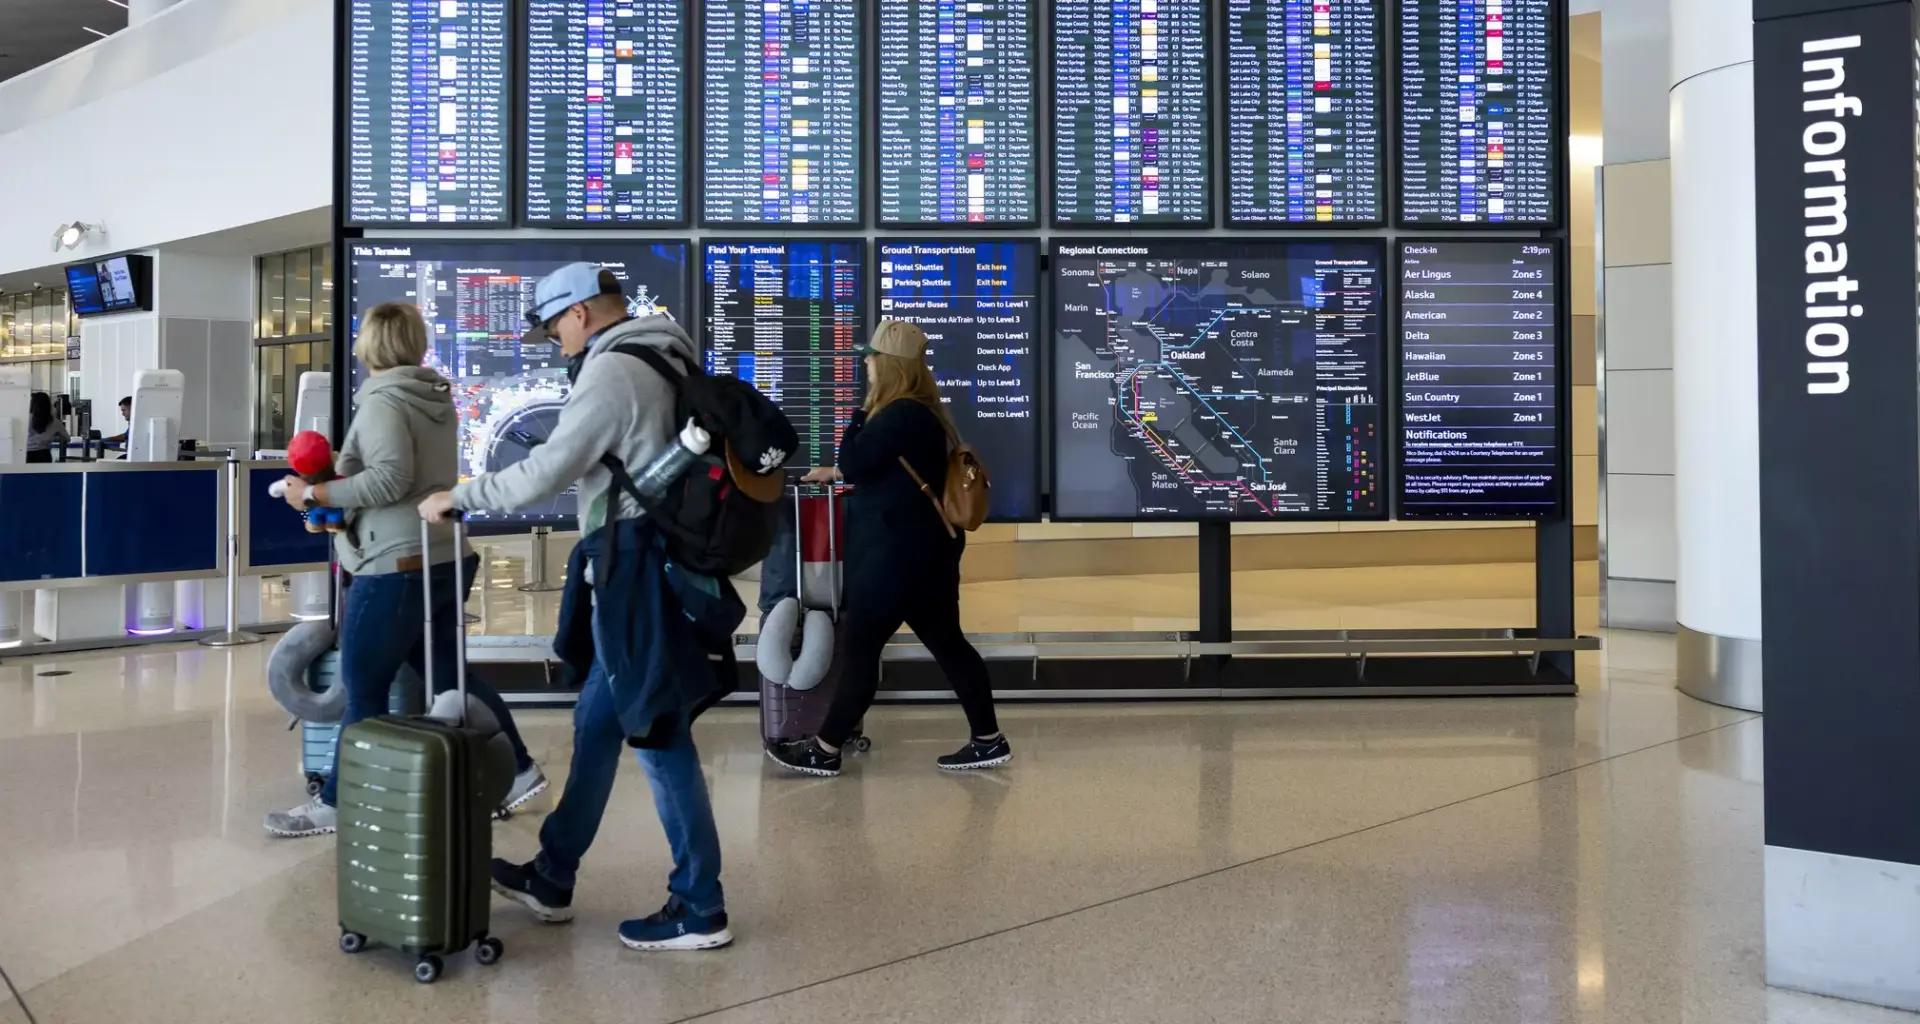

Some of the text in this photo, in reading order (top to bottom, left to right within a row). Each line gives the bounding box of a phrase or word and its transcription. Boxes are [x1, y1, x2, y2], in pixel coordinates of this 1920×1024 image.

[1802, 35, 1863, 394] Information
[354, 247, 411, 256] This Terminal
[708, 246, 785, 254] Find Your Terminal
[882, 246, 976, 255] Ground Transportation
[1060, 246, 1148, 256] Regional Connections
[1404, 246, 1550, 255] Check-In 2:19pm
[1062, 268, 1095, 276] Sonoma
[1177, 266, 1198, 276] Napa
[1241, 271, 1270, 279] Solano
[1404, 270, 1542, 280] Aer Lingus Zone 5
[895, 279, 921, 287] Parking
[1405, 290, 1543, 299] Alaska Zone 4
[895, 301, 926, 309] Airporter
[1405, 311, 1542, 319] American Zone 2
[977, 316, 987, 324] Up
[1231, 330, 1258, 338] Contra
[1405, 331, 1543, 340] Delta Zone 3
[1231, 339, 1254, 347] Costa
[1171, 351, 1205, 360] Oakland
[1405, 352, 1543, 361] Hawaiian Zone 5
[998, 364, 1011, 372] App
[1075, 362, 1091, 370] San
[1075, 370, 1114, 379] Francisco
[1258, 368, 1294, 376] Alameda
[1405, 372, 1542, 381] JetBlue Zone 1
[1405, 393, 1542, 403] Sun Country Zone 1
[1405, 413, 1542, 422] WestJet Zone 1
[1072, 421, 1098, 429] Ocean
[1406, 430, 1467, 439] Notifications
[1274, 438, 1298, 446] Santa
[1274, 446, 1296, 455] Clara
[1152, 472, 1167, 480] San
[1250, 482, 1287, 491] San José
